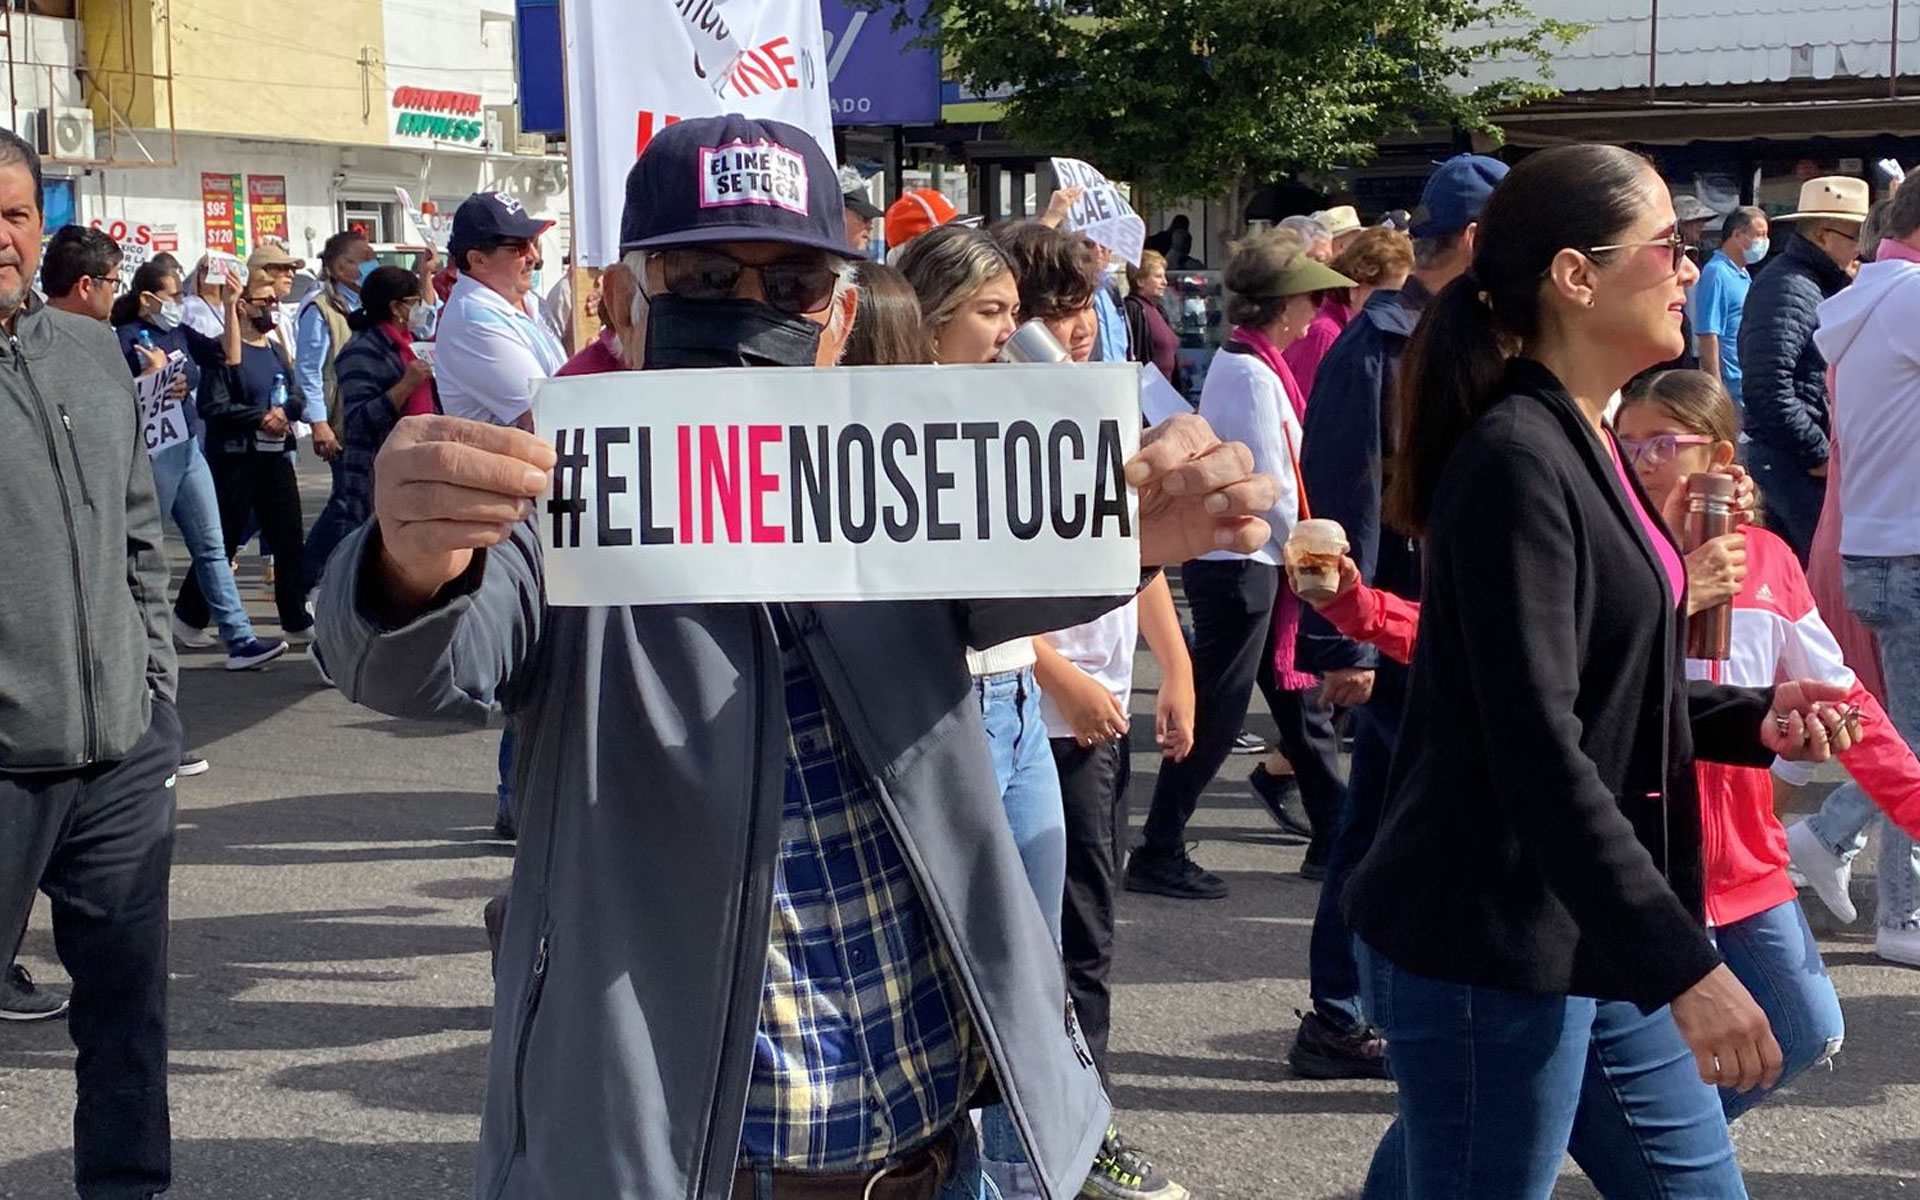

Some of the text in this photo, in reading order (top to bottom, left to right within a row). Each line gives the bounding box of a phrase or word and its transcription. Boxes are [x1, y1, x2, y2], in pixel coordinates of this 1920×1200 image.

[731, 36, 798, 98] INE
[829, 97, 872, 113] ADO
[711, 156, 730, 175] EL
[735, 153, 770, 170] INE
[717, 172, 800, 202] SE TOCA
[206, 201, 226, 217] $95
[207, 228, 233, 244] $120
[143, 417, 178, 449] CA
[547, 419, 1131, 549] #ELINENOSETOCA
